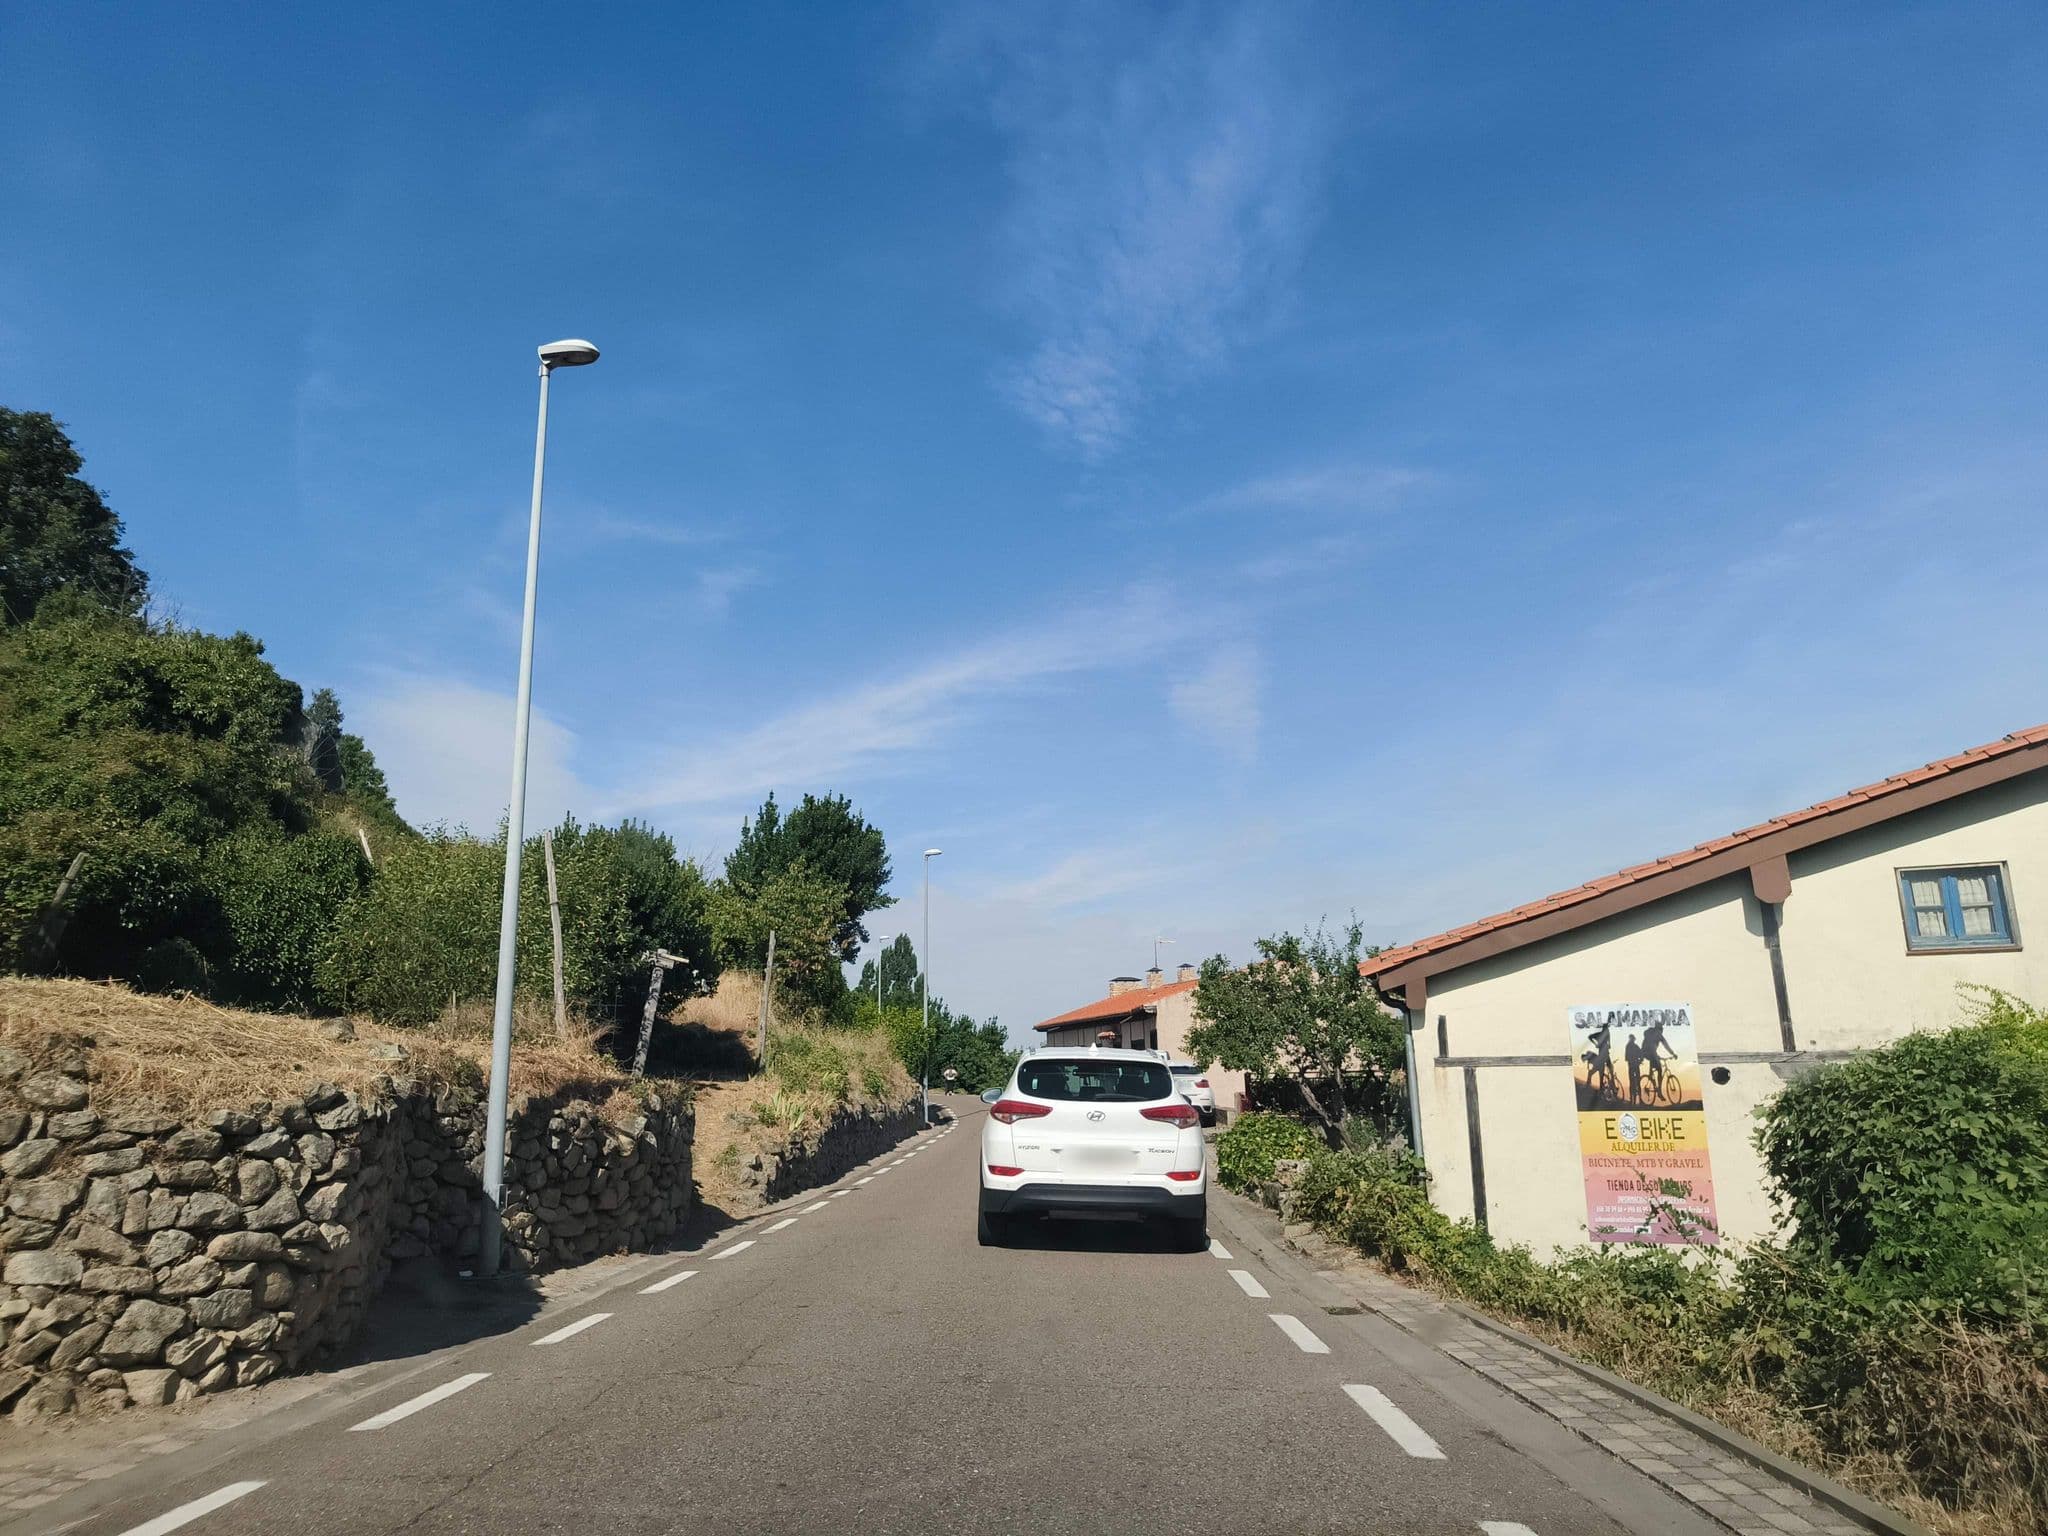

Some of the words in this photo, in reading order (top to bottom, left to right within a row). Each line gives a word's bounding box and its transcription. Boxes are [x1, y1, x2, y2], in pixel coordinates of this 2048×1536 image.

[1574, 1009, 1690, 1029] SALAMANDRA
[1640, 1117, 1685, 1140] BIKE
[1611, 1142, 1661, 1154] ALQUILER
[1662, 1142, 1676, 1152] DE
[1636, 1158, 1657, 1168] MTB
[1658, 1158, 1665, 1168] Y
[1665, 1158, 1704, 1168] GRAVEL
[1607, 1179, 1634, 1191] TIENDA
